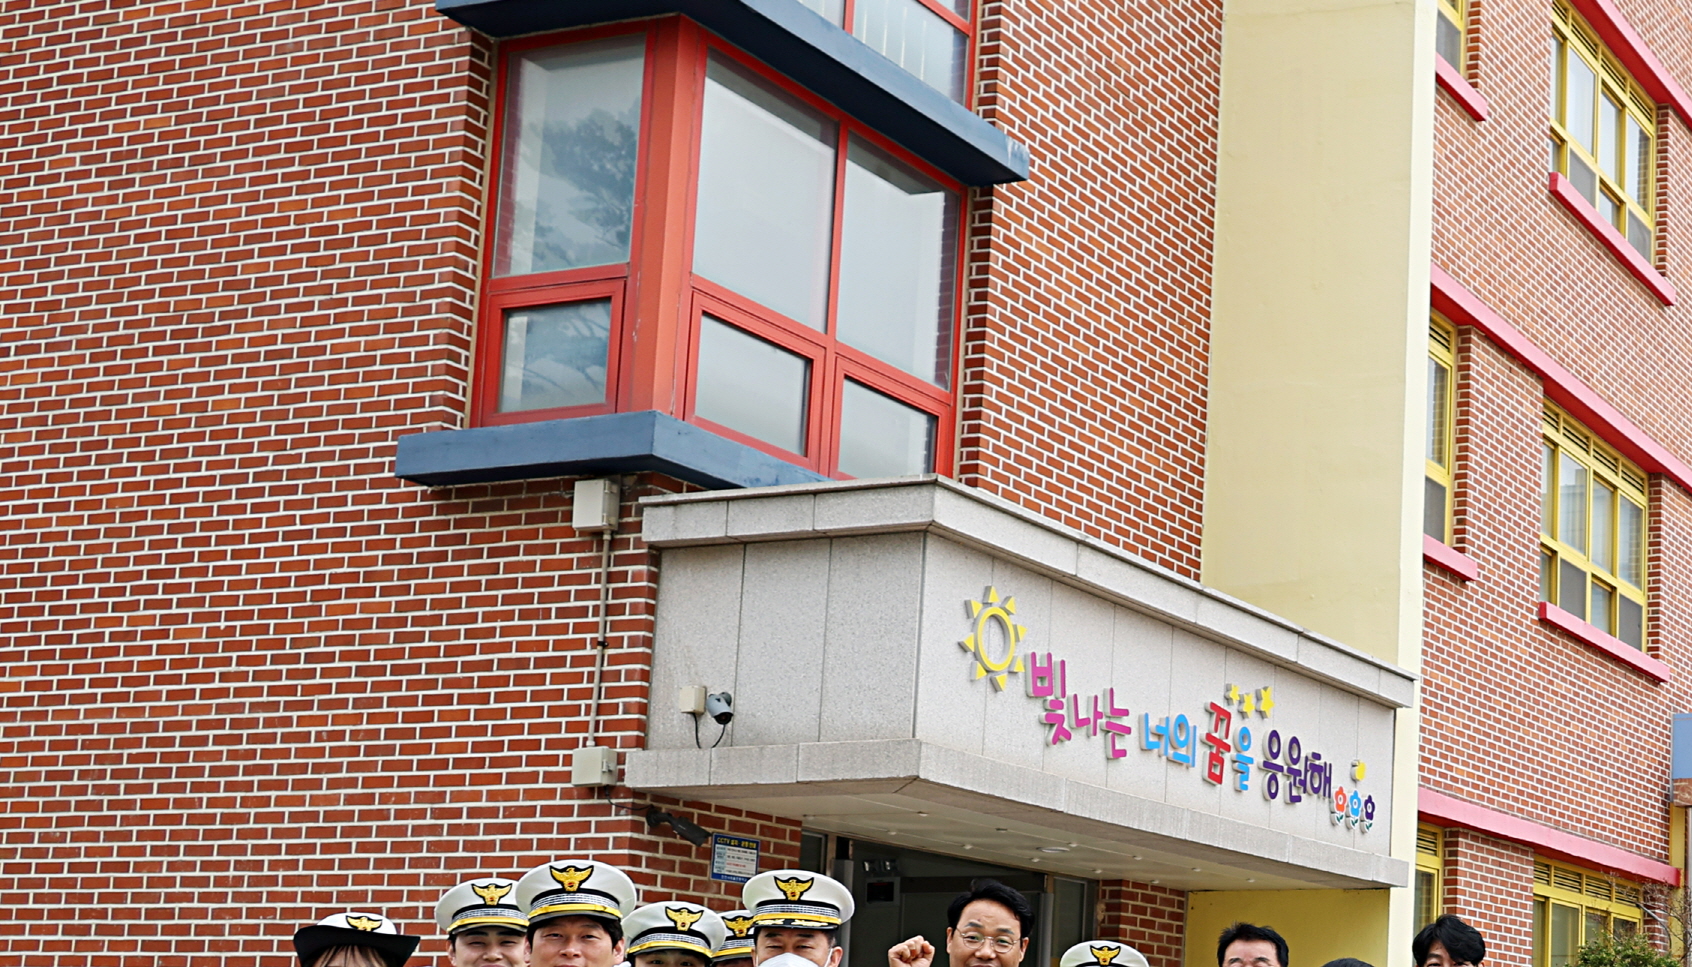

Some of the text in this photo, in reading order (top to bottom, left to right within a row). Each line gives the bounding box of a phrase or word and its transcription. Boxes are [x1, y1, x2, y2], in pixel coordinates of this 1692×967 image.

[1026, 651, 1333, 804] 빛나는 너의 꿈을 응원해
